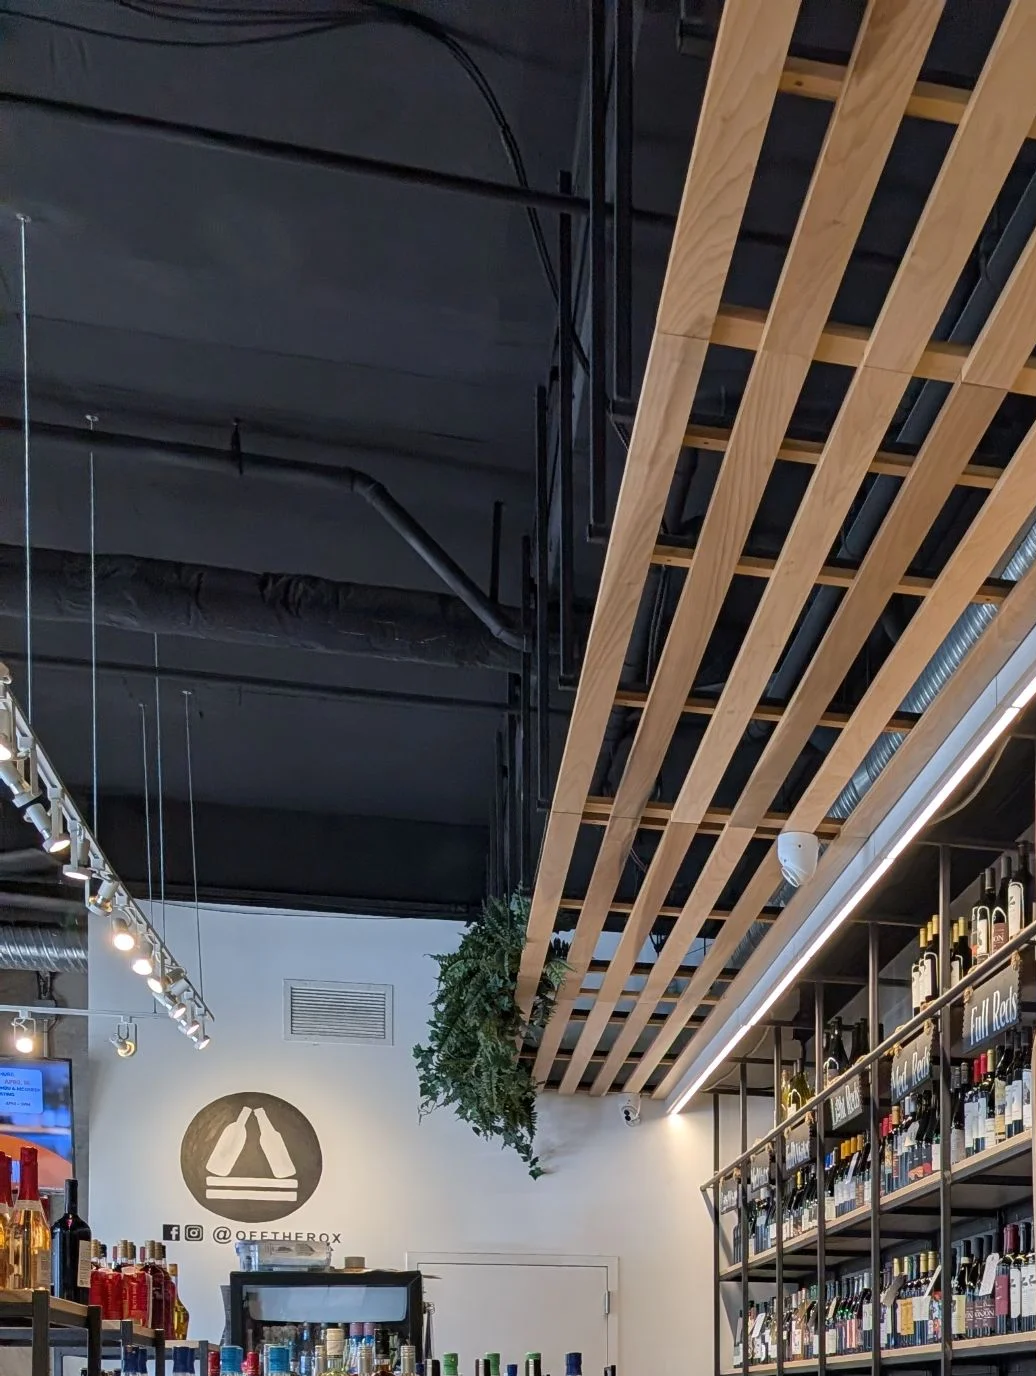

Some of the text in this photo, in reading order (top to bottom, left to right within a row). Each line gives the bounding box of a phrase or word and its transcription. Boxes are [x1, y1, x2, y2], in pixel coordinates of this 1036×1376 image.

[970, 985, 1018, 1046] Full Reds
[912, 1046, 930, 1086] Reds
